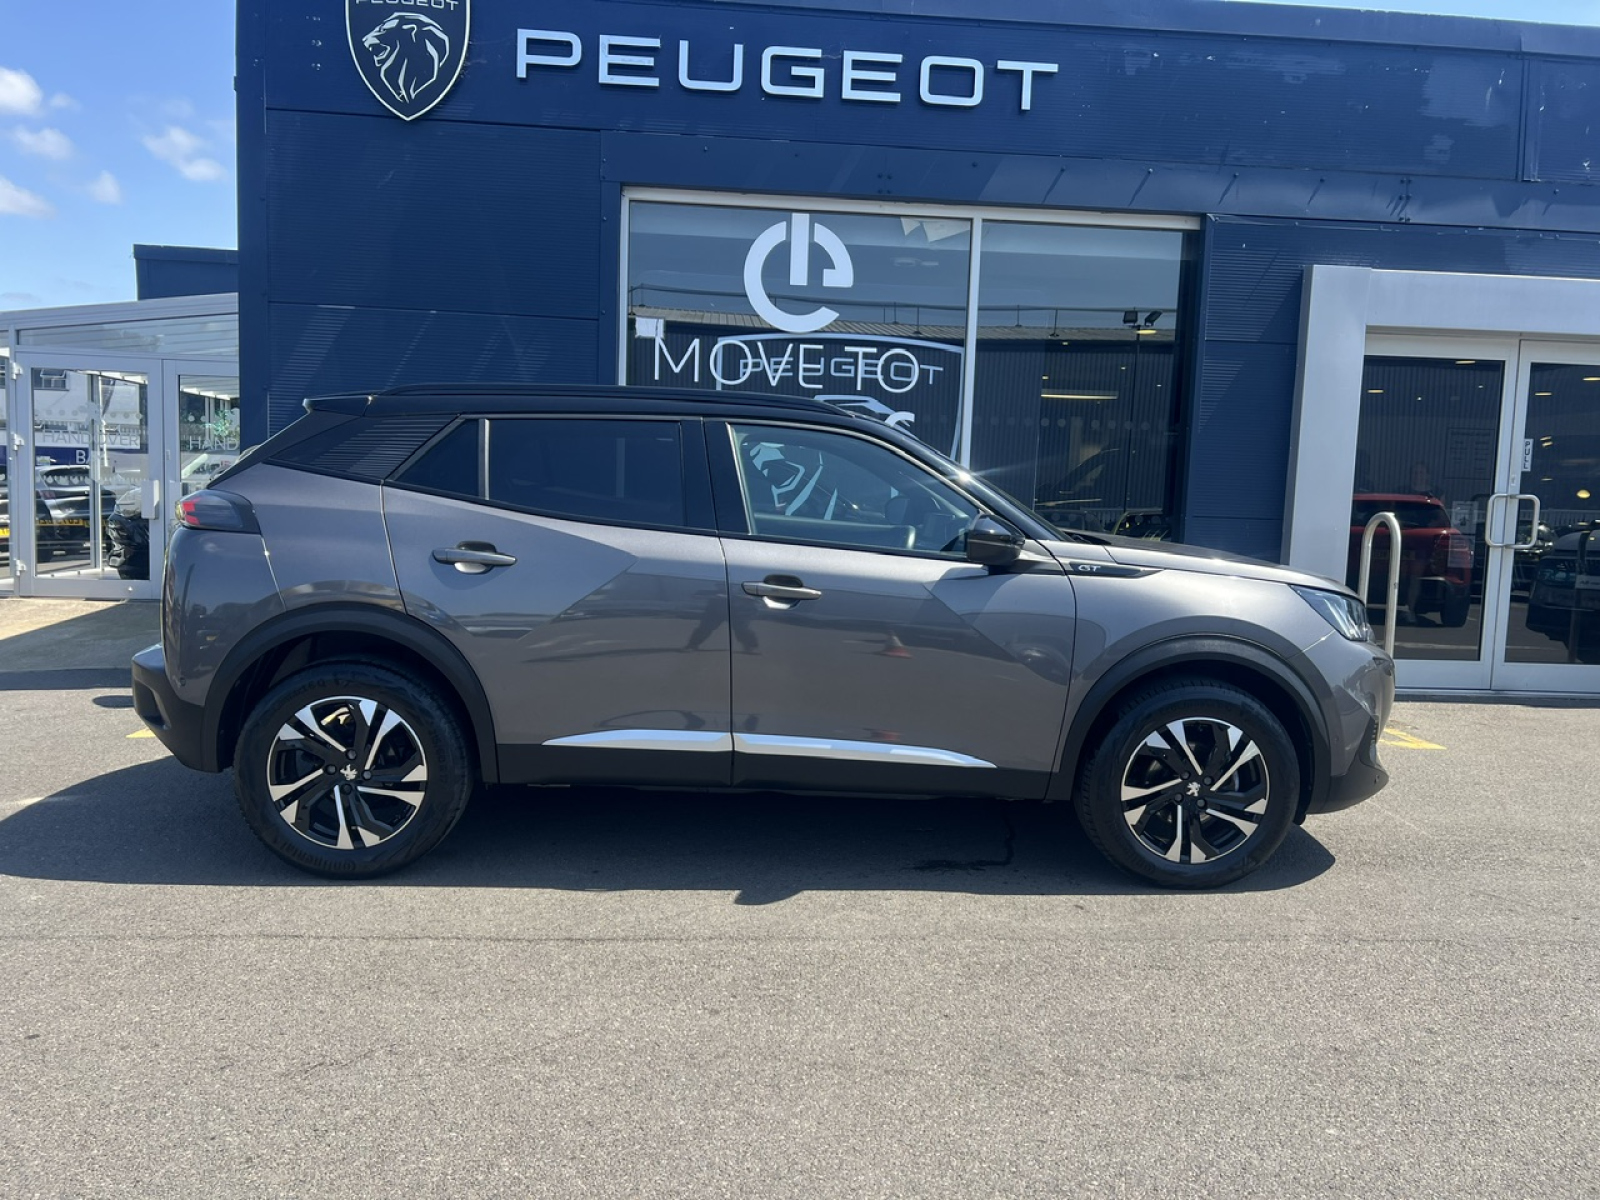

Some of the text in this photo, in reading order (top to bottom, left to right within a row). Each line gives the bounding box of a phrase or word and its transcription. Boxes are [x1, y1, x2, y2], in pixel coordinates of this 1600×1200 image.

[516, 28, 1059, 110] PEUGEOT
[654, 335, 919, 393] MOVE TO
[739, 357, 944, 384] PEUGEOT
[1523, 441, 1531, 469] PULL
[1078, 564, 1101, 572] GT
